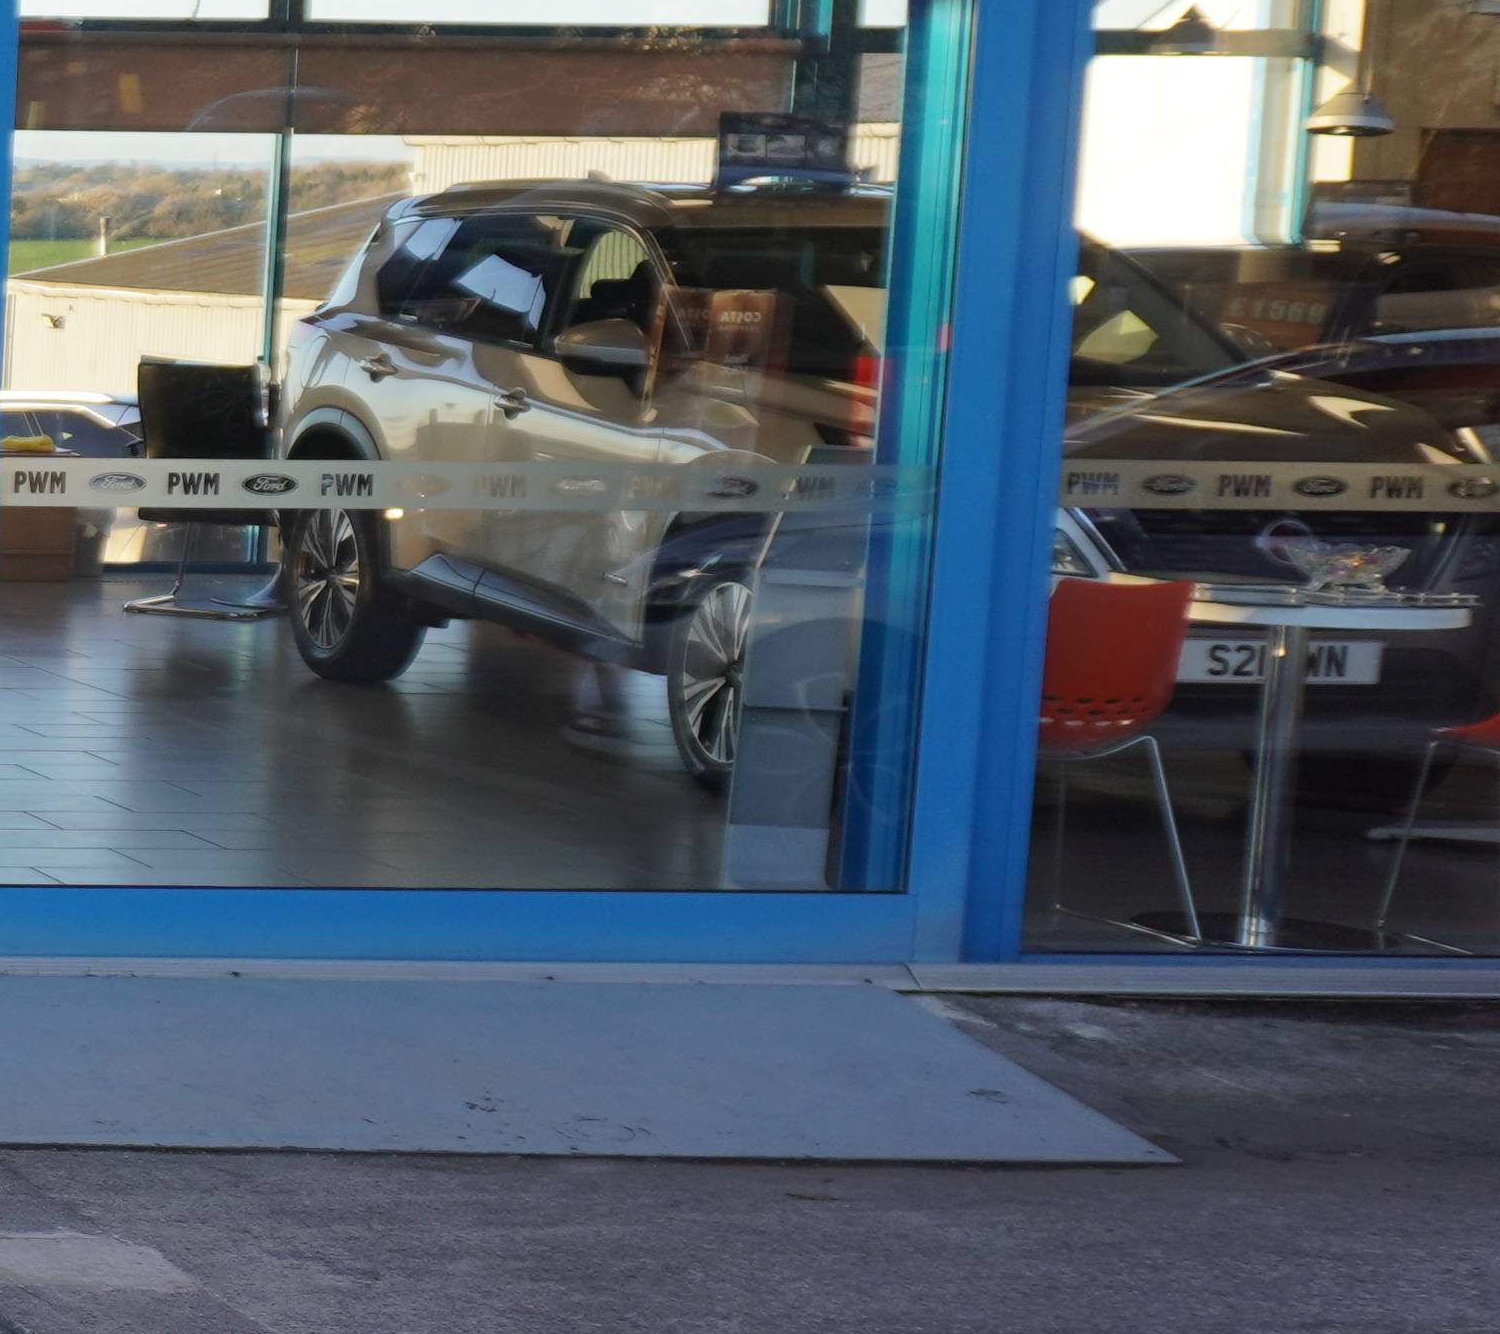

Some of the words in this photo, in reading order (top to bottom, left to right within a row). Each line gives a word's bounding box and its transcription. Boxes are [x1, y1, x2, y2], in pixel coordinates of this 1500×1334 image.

[14, 470, 67, 494] PWM
[98, 474, 140, 492] Ford
[167, 472, 220, 496] PWM
[250, 475, 291, 494] Ford
[321, 473, 374, 497] PWM
[1067, 472, 1119, 495] PWM
[1218, 474, 1272, 498] PWM
[1370, 475, 1424, 499] PWM
